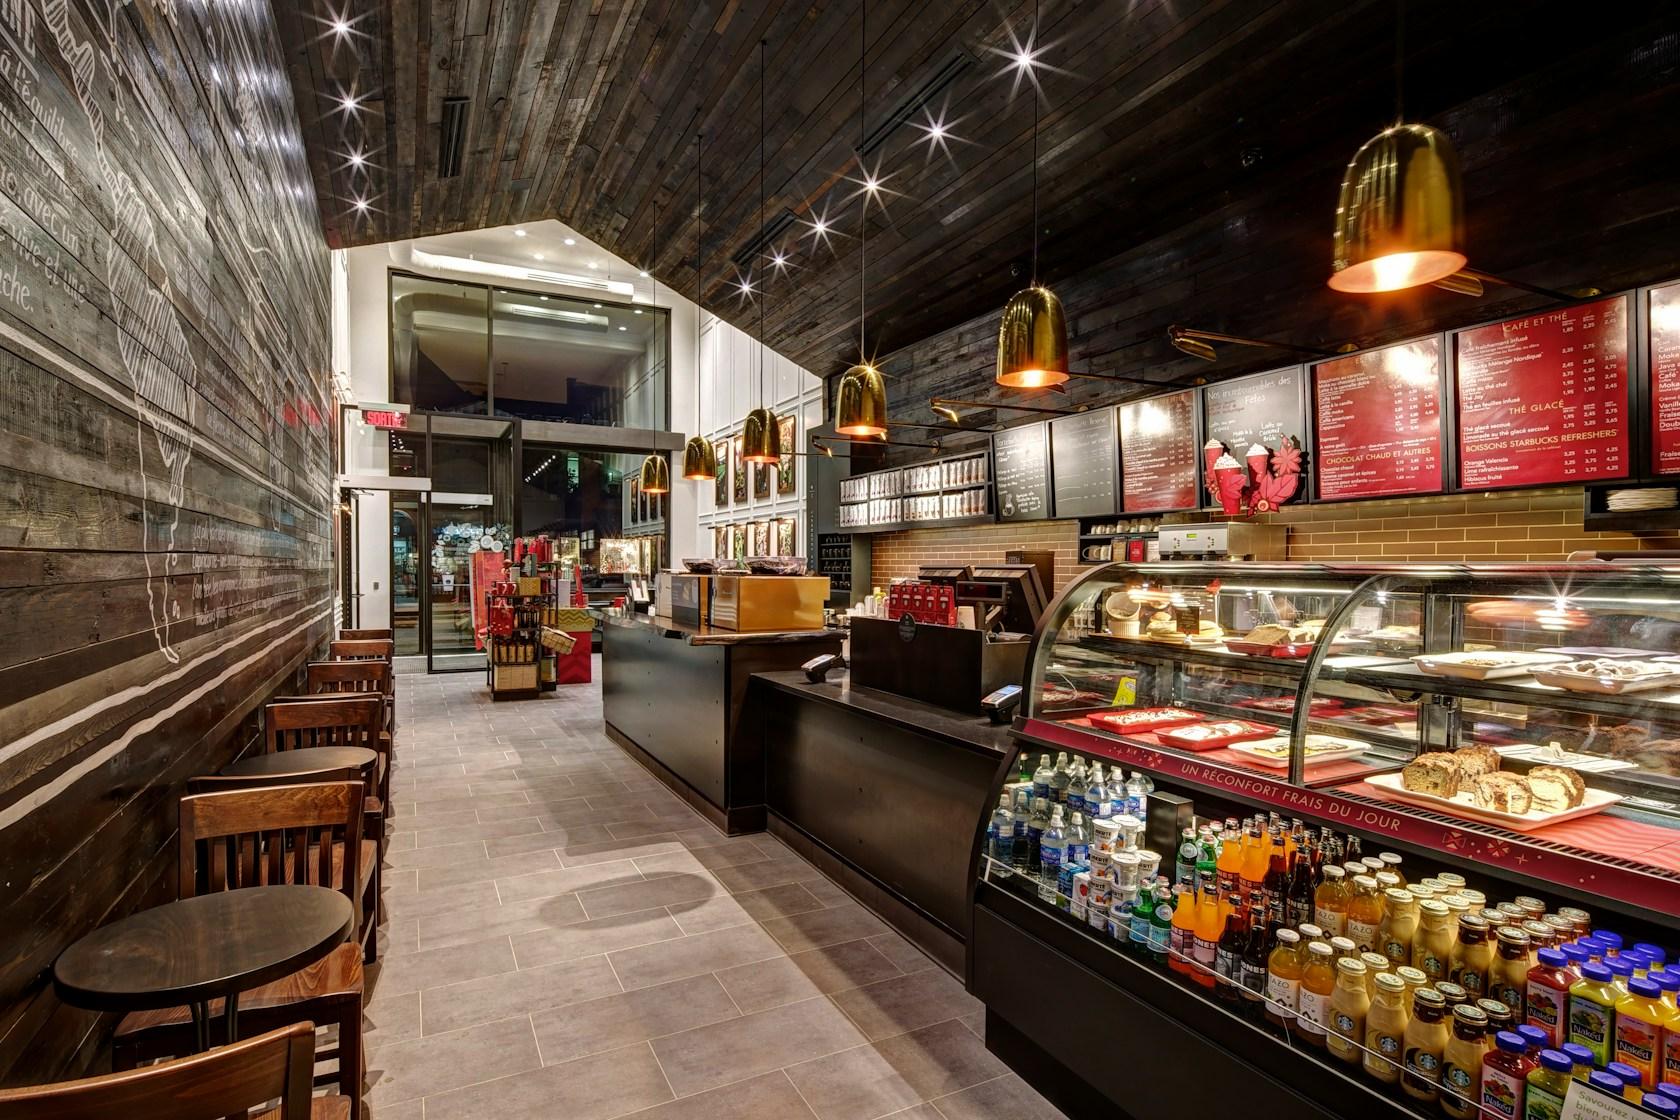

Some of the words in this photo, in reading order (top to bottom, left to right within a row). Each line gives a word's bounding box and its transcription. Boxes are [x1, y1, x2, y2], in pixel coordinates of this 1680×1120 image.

[24, 186, 58, 236] avec
[1504, 320, 1530, 333] CAFÉ
[1533, 317, 1545, 327] ET
[1548, 312, 1568, 322] THÉ
[1509, 404, 1527, 415] THÉ
[1530, 399, 1564, 412] GLACÉ
[1466, 441, 1508, 453] BOISSONS
[1510, 435, 1559, 448] STARBUCKS
[1561, 429, 1617, 442] REFRESHERS
[1327, 455, 1364, 465] CHOCOLAT
[1366, 452, 1391, 461] CHAUD
[1393, 449, 1401, 457] ET
[1403, 446, 1431, 456] AUTRES
[1180, 763, 1199, 777] UN
[1202, 769, 1279, 797] RÉCONFORT
[1282, 790, 1323, 810] FRAIS
[1328, 803, 1351, 817] DU
[1355, 810, 1401, 831] JOUR
[1529, 1008, 1554, 1025] Naked
[1573, 1024, 1601, 1042] Naked
[1619, 1040, 1650, 1060] Naked
[1485, 1094, 1512, 1114] Naked
[1575, 1100, 1599, 1117] bien
[1579, 1090, 1628, 1119] Savourez
